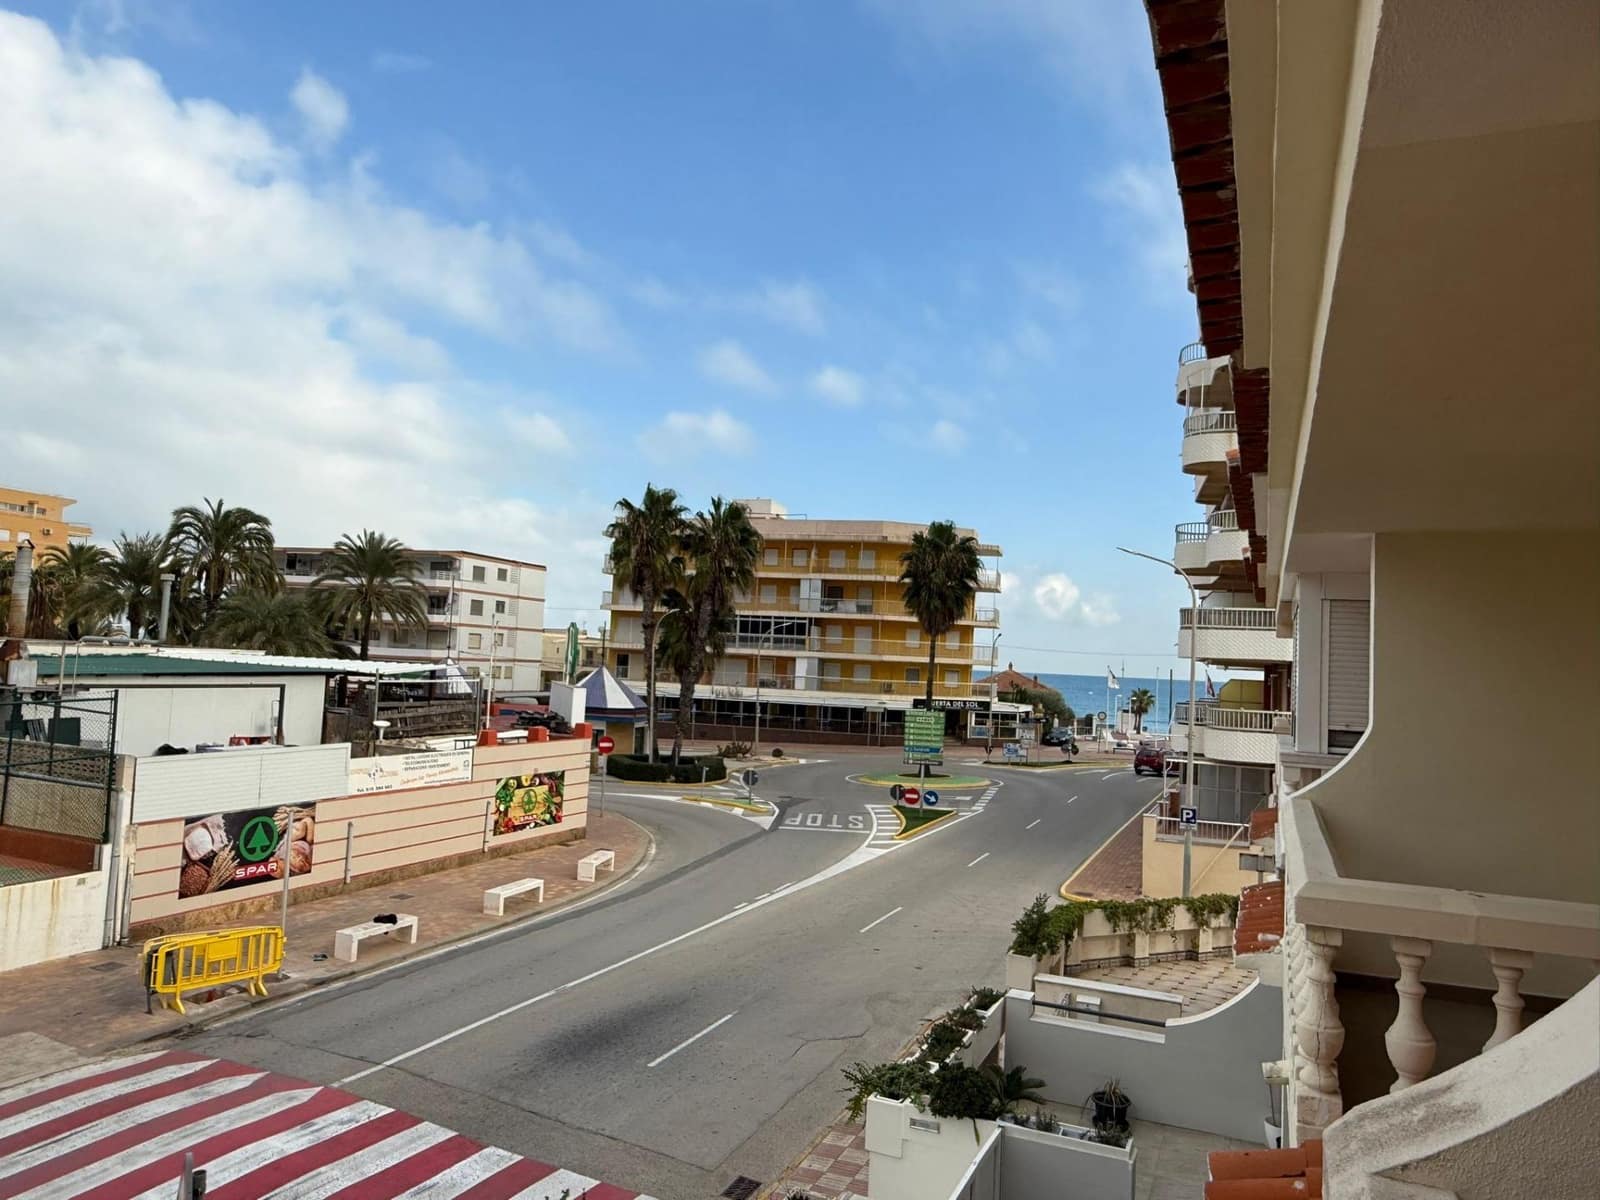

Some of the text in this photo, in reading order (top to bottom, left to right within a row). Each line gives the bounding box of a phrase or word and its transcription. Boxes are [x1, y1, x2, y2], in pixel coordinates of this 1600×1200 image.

[784, 812, 865, 829] STOP
[1182, 809, 1194, 822] P
[235, 862, 278, 878] SPAR
